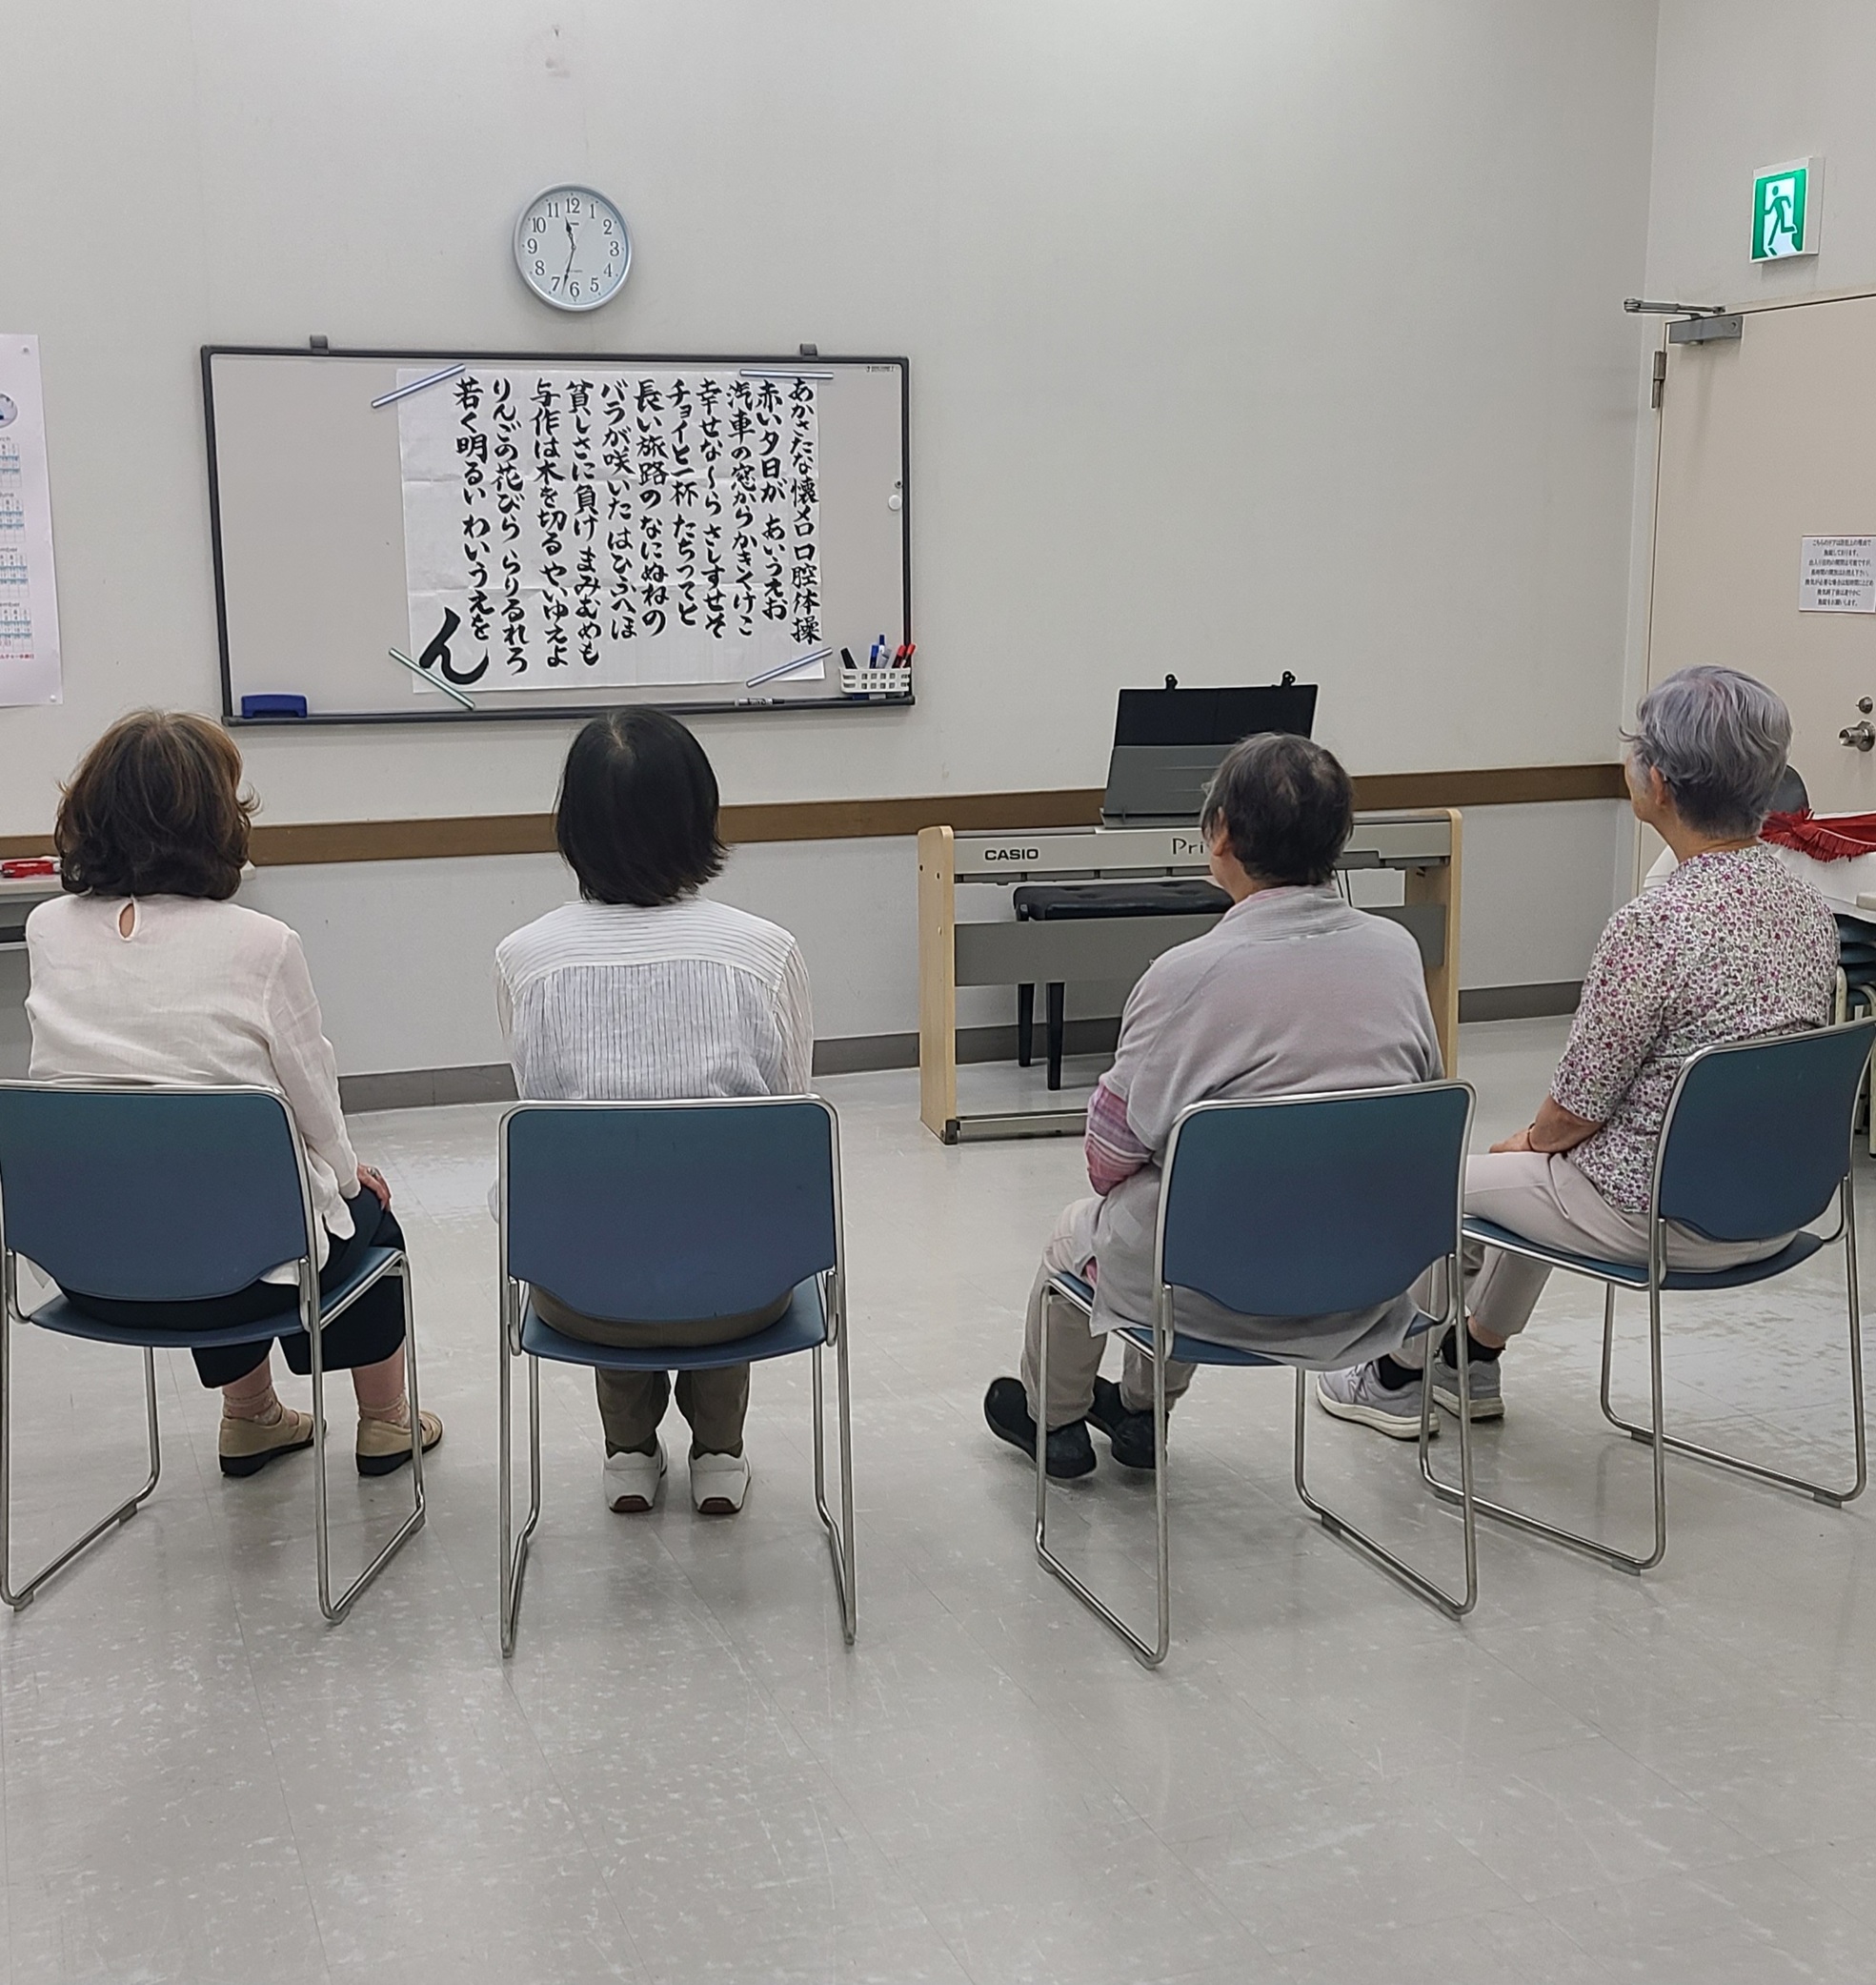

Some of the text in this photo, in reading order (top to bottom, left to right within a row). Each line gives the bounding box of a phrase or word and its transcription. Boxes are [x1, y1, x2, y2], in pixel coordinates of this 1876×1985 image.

[548, 202, 559, 218] 11
[566, 197, 580, 213] 12
[590, 203, 595, 219] 1
[532, 217, 546, 233] 10
[603, 219, 613, 235] 2
[527, 238, 537, 254] 9
[610, 241, 619, 256] 3
[535, 260, 545, 275] 8
[603, 262, 612, 277] 4
[551, 276, 560, 292] 7
[569, 281, 579, 297] 6
[590, 277, 599, 293] 5
[419, 607, 489, 685] ん
[984, 848, 1039, 861] CASIO
[1173, 838, 1204, 855] Pri
